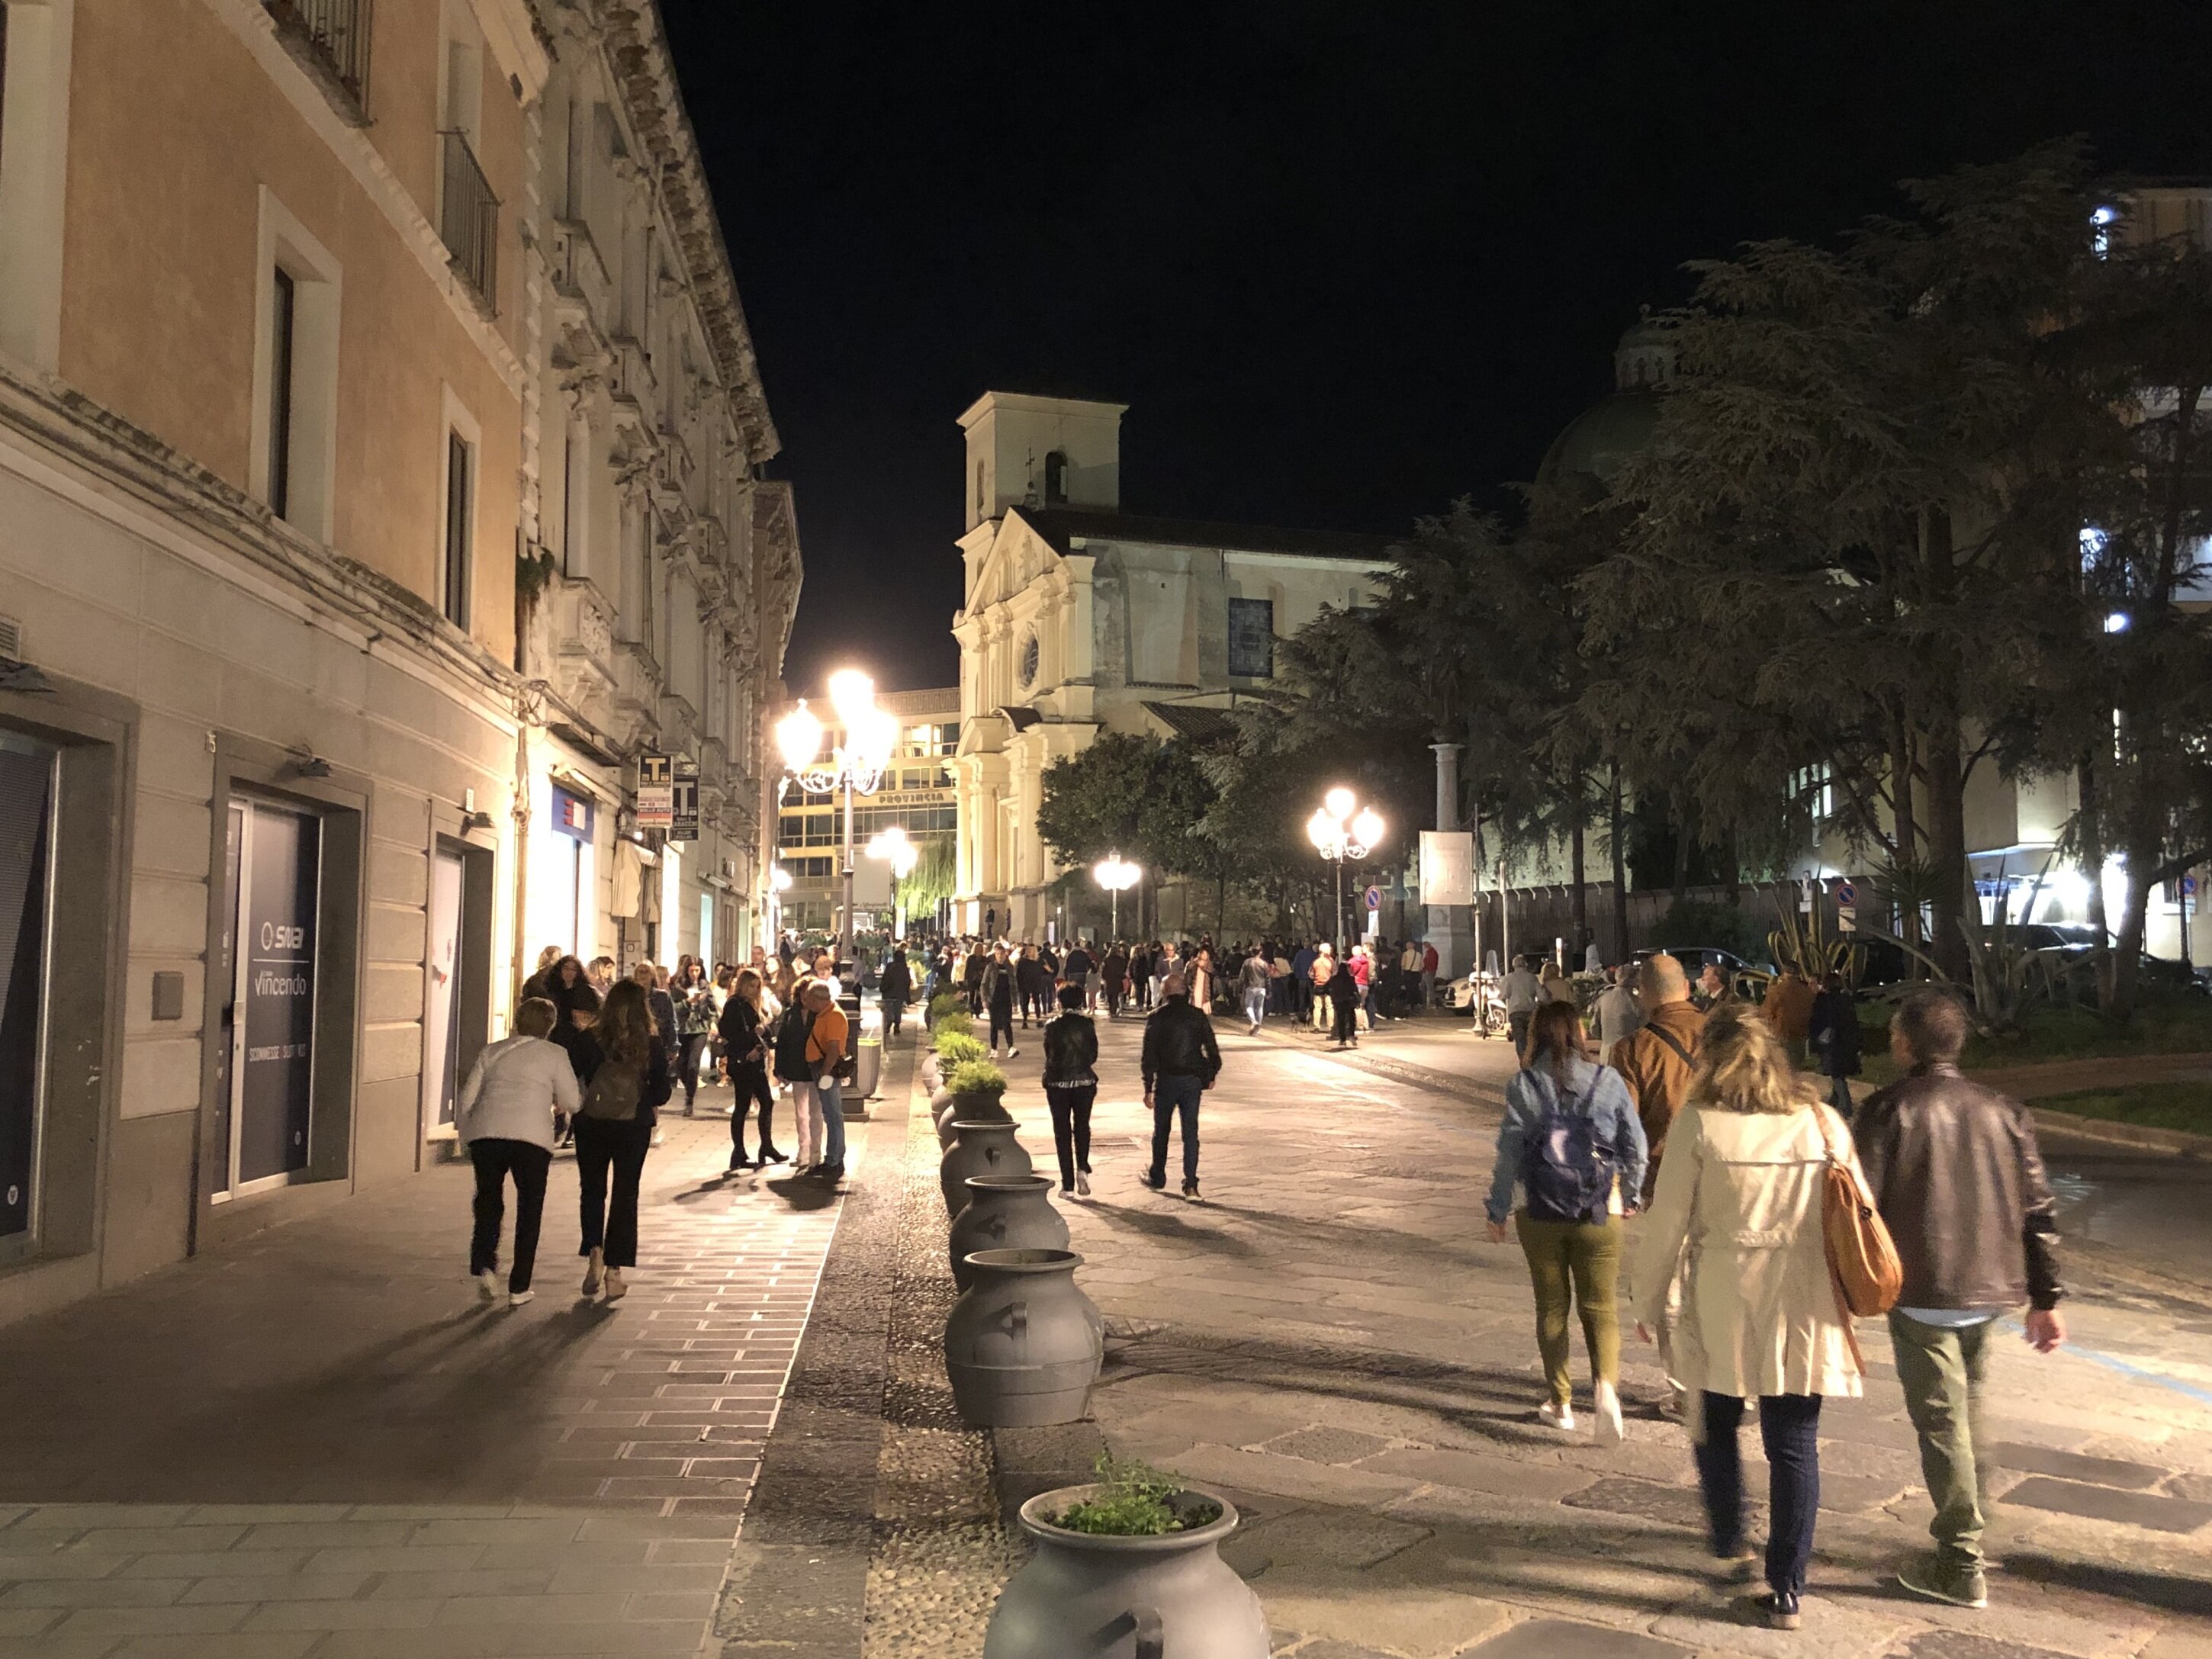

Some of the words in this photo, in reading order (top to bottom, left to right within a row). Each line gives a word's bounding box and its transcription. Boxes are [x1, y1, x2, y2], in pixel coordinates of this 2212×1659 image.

[645, 758, 666, 781] T
[674, 782, 694, 815] T
[879, 793, 944, 804] PROVINCIA
